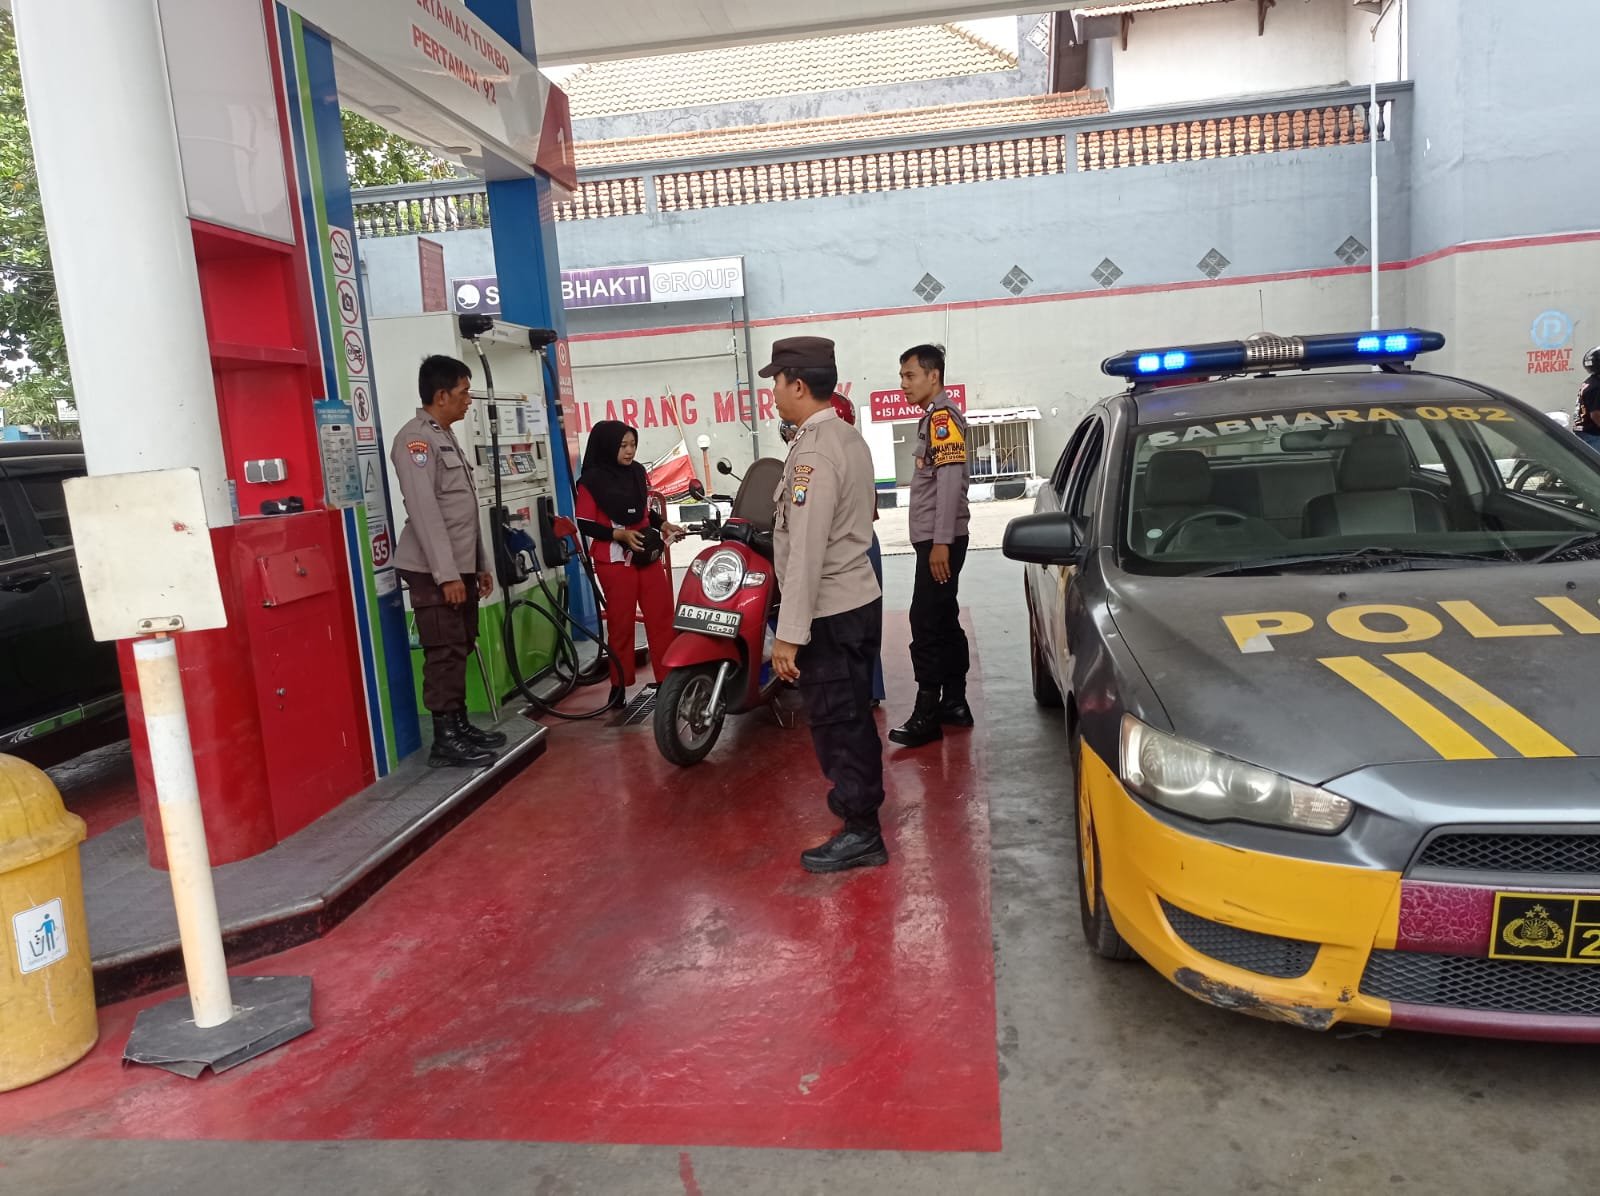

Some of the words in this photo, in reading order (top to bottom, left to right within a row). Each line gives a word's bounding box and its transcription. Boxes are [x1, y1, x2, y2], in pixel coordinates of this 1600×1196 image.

[411, 23, 480, 93] PERTAMAX
[483, 78, 497, 105] 92
[470, 27, 510, 76] TURBO
[557, 127, 567, 166] 1
[561, 275, 646, 300] BHAKTI
[652, 267, 740, 293] GROUP
[1526, 349, 1573, 363] TEMPAT
[882, 394, 900, 404] AIR
[882, 407, 895, 417] ISI
[1148, 407, 1404, 447] SABHARA
[1415, 406, 1516, 422] 082
[1221, 596, 1600, 654] POLI
